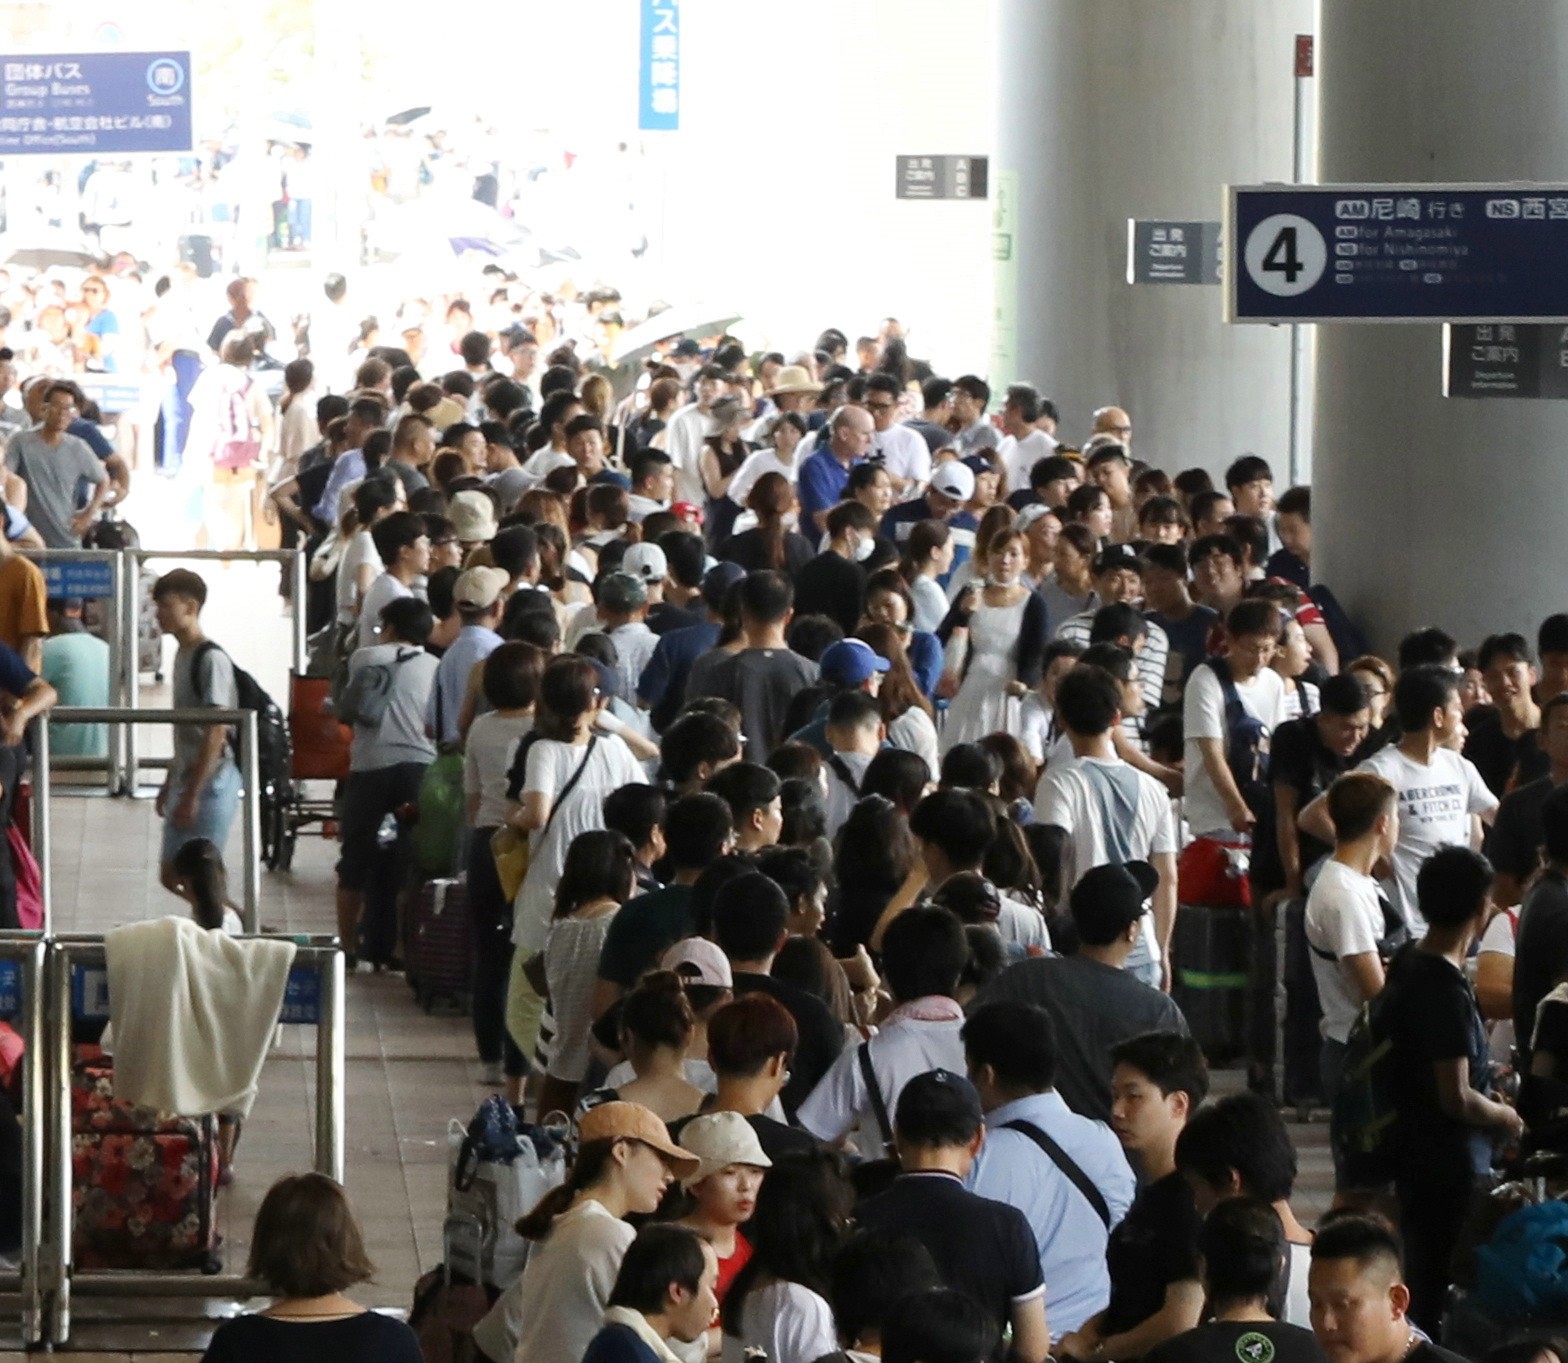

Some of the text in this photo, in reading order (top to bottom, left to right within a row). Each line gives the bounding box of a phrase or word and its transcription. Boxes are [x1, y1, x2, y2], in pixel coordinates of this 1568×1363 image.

[4, 83, 48, 98] Group
[1371, 197, 1421, 220] 尼崎
[1428, 201, 1464, 219] 行き
[1152, 228, 1184, 241] 出発
[1383, 225, 1458, 241] Amagasaki
[1149, 243, 1187, 258] ご案内
[1261, 226, 1304, 284] 4
[1383, 243, 1470, 257] Nishinomiya
[1476, 324, 1516, 341] 出発
[1472, 345, 1519, 362] ご案内
